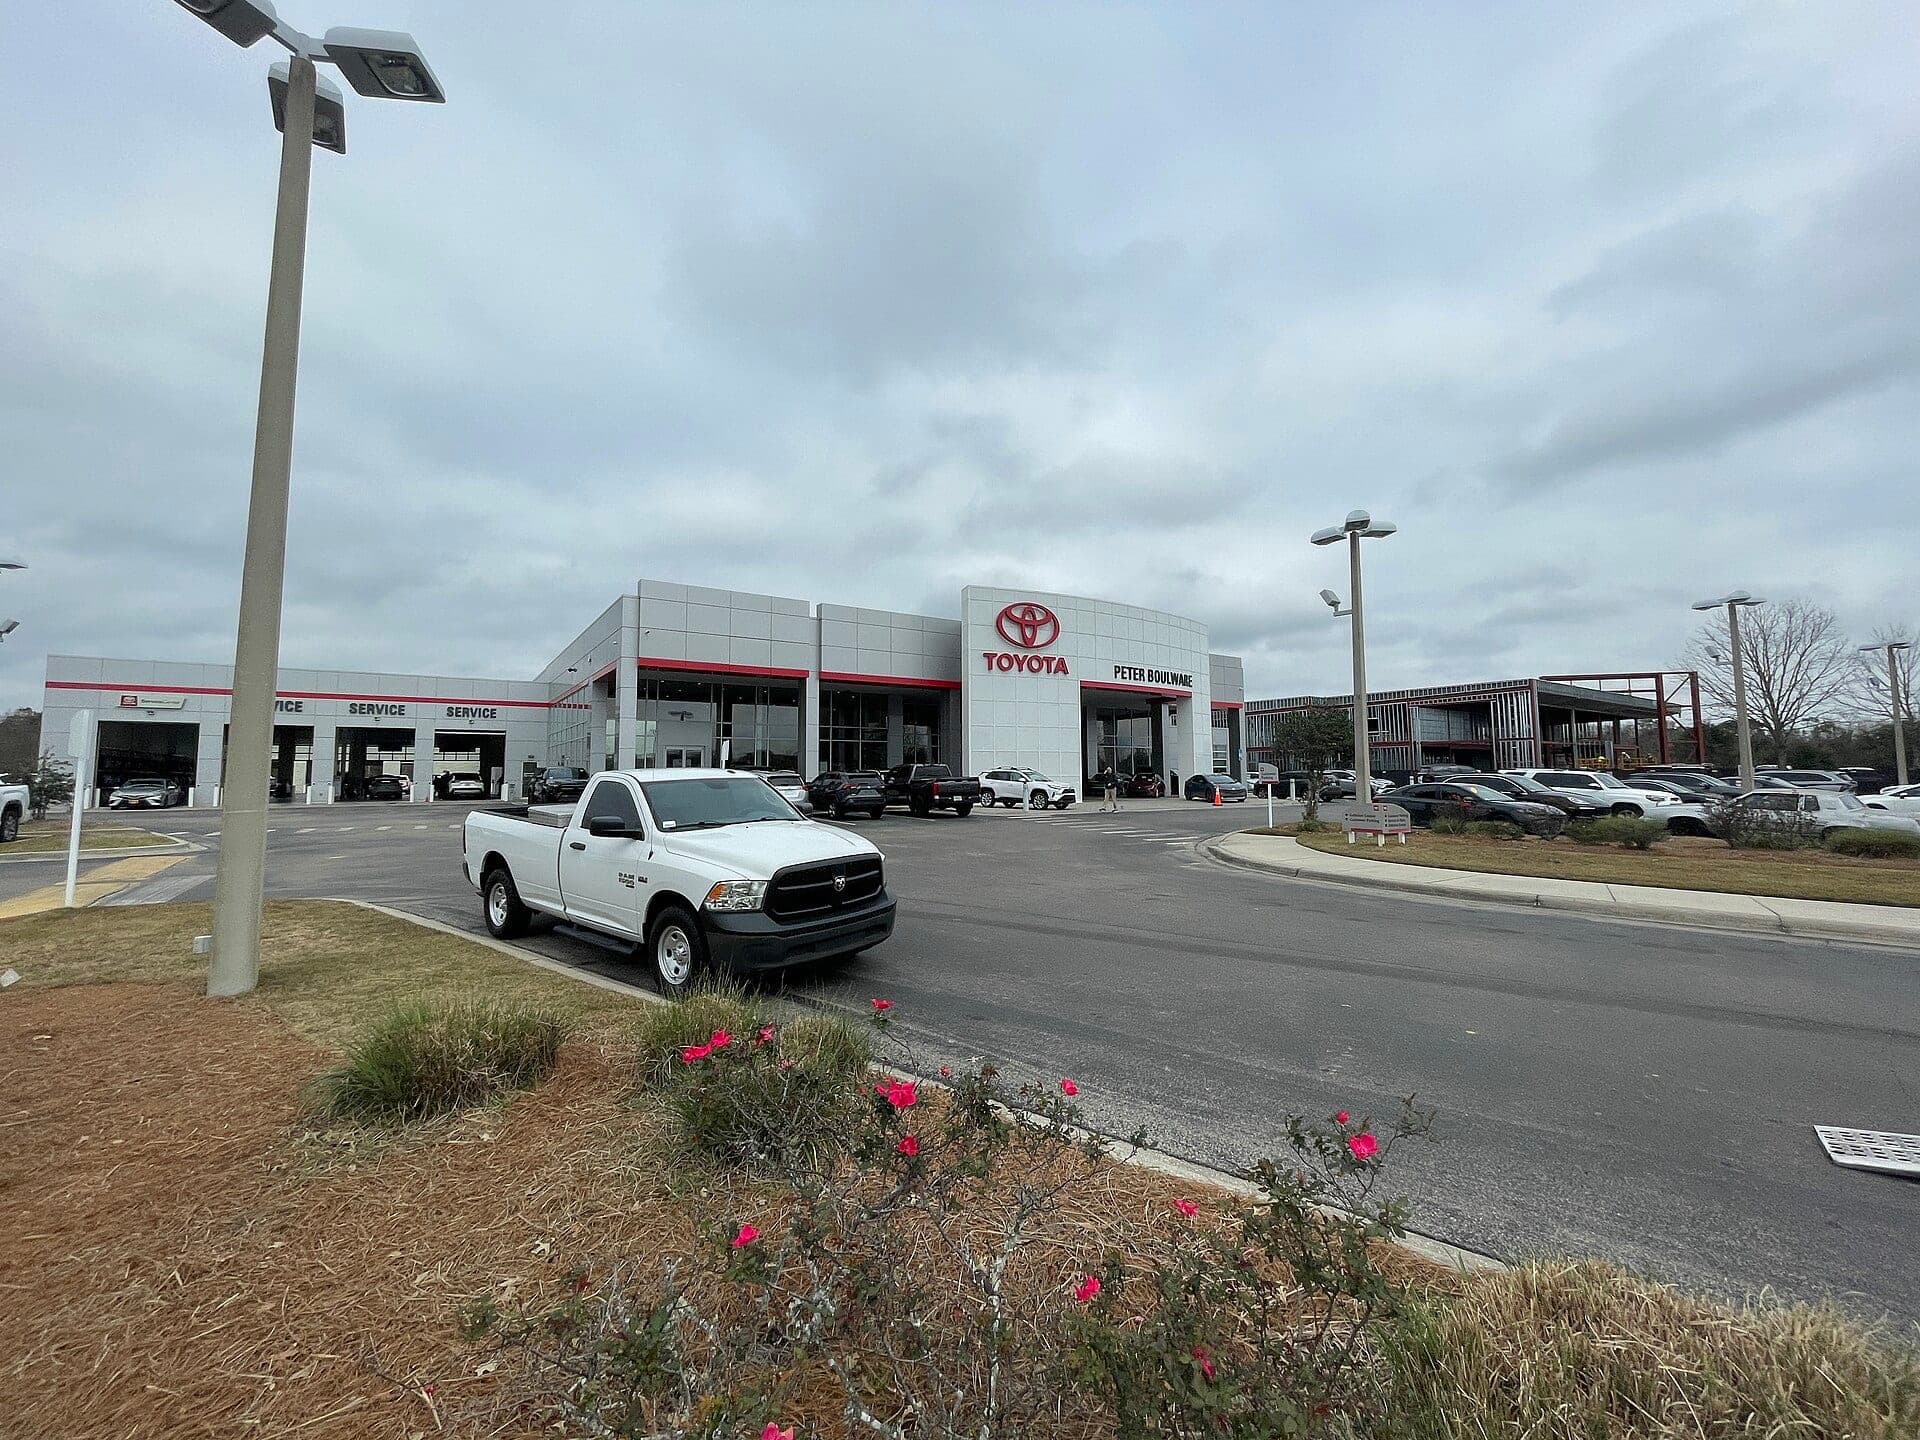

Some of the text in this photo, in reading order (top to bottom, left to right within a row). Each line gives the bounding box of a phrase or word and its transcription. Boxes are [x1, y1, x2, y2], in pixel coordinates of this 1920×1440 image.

[983, 653, 1069, 675] TOYOTA
[1114, 665, 1193, 688] PETER BOULWARE
[275, 700, 303, 712] VICE
[349, 702, 405, 716] SERVICE
[446, 706, 497, 719] SERVICE
